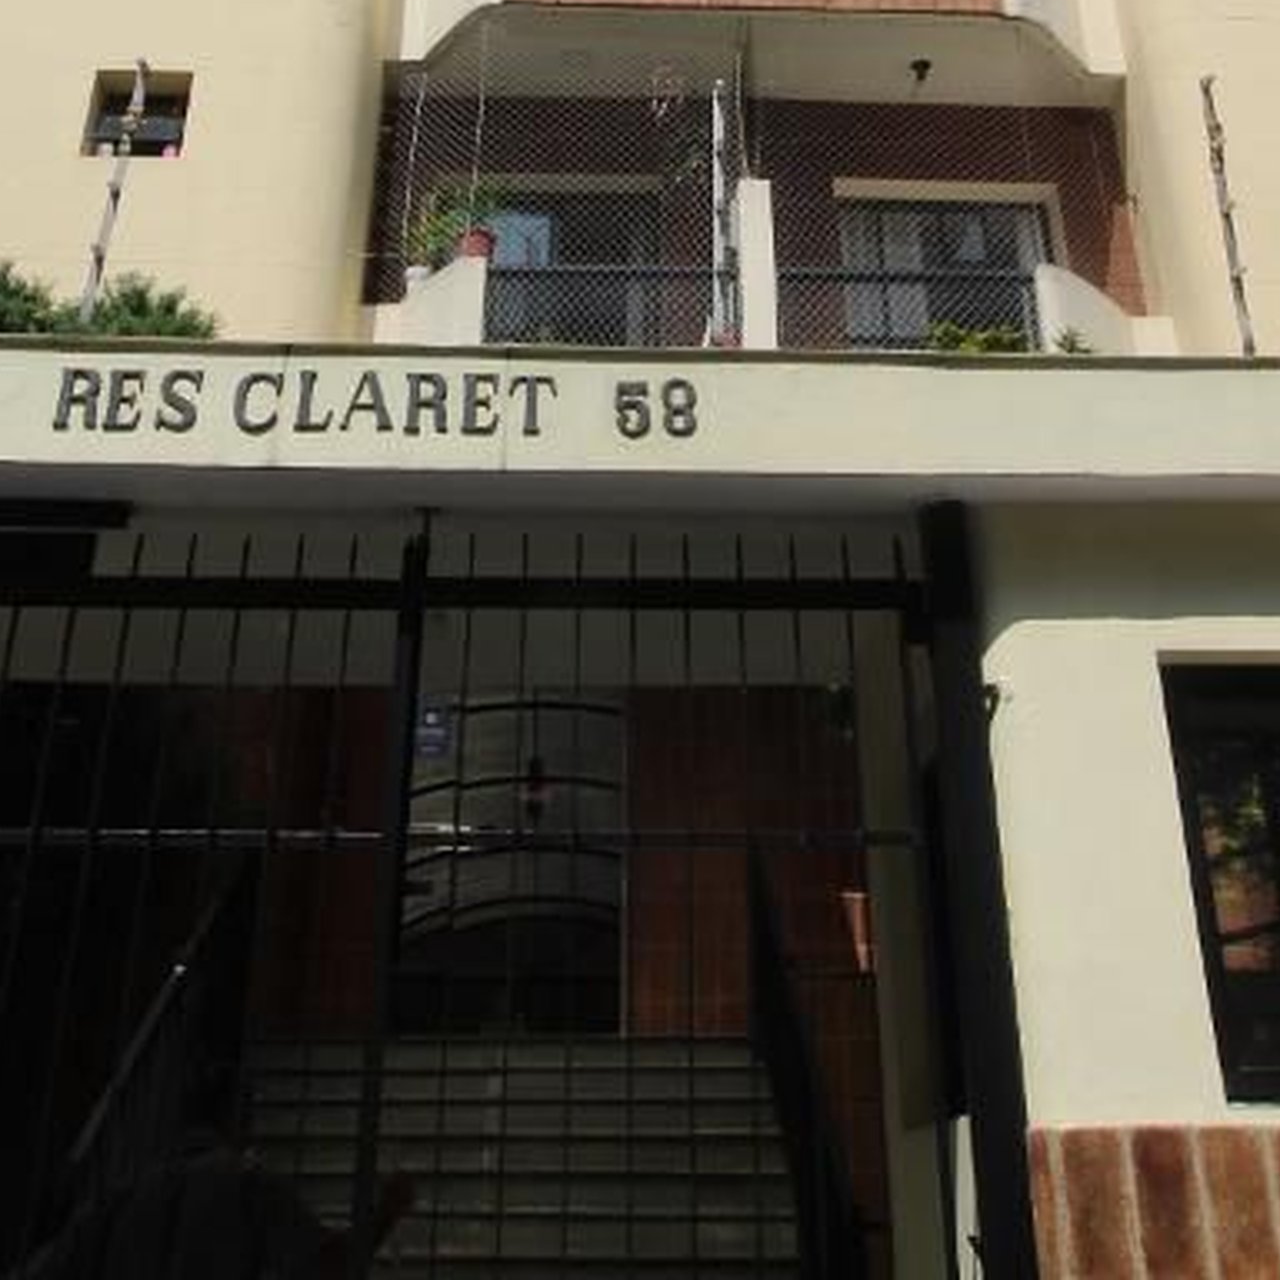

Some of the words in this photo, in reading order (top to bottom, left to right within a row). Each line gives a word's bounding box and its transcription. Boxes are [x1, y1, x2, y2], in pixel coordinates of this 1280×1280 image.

[52, 367, 205, 434] RES
[233, 370, 557, 436] CLARET
[615, 377, 698, 440] 58
